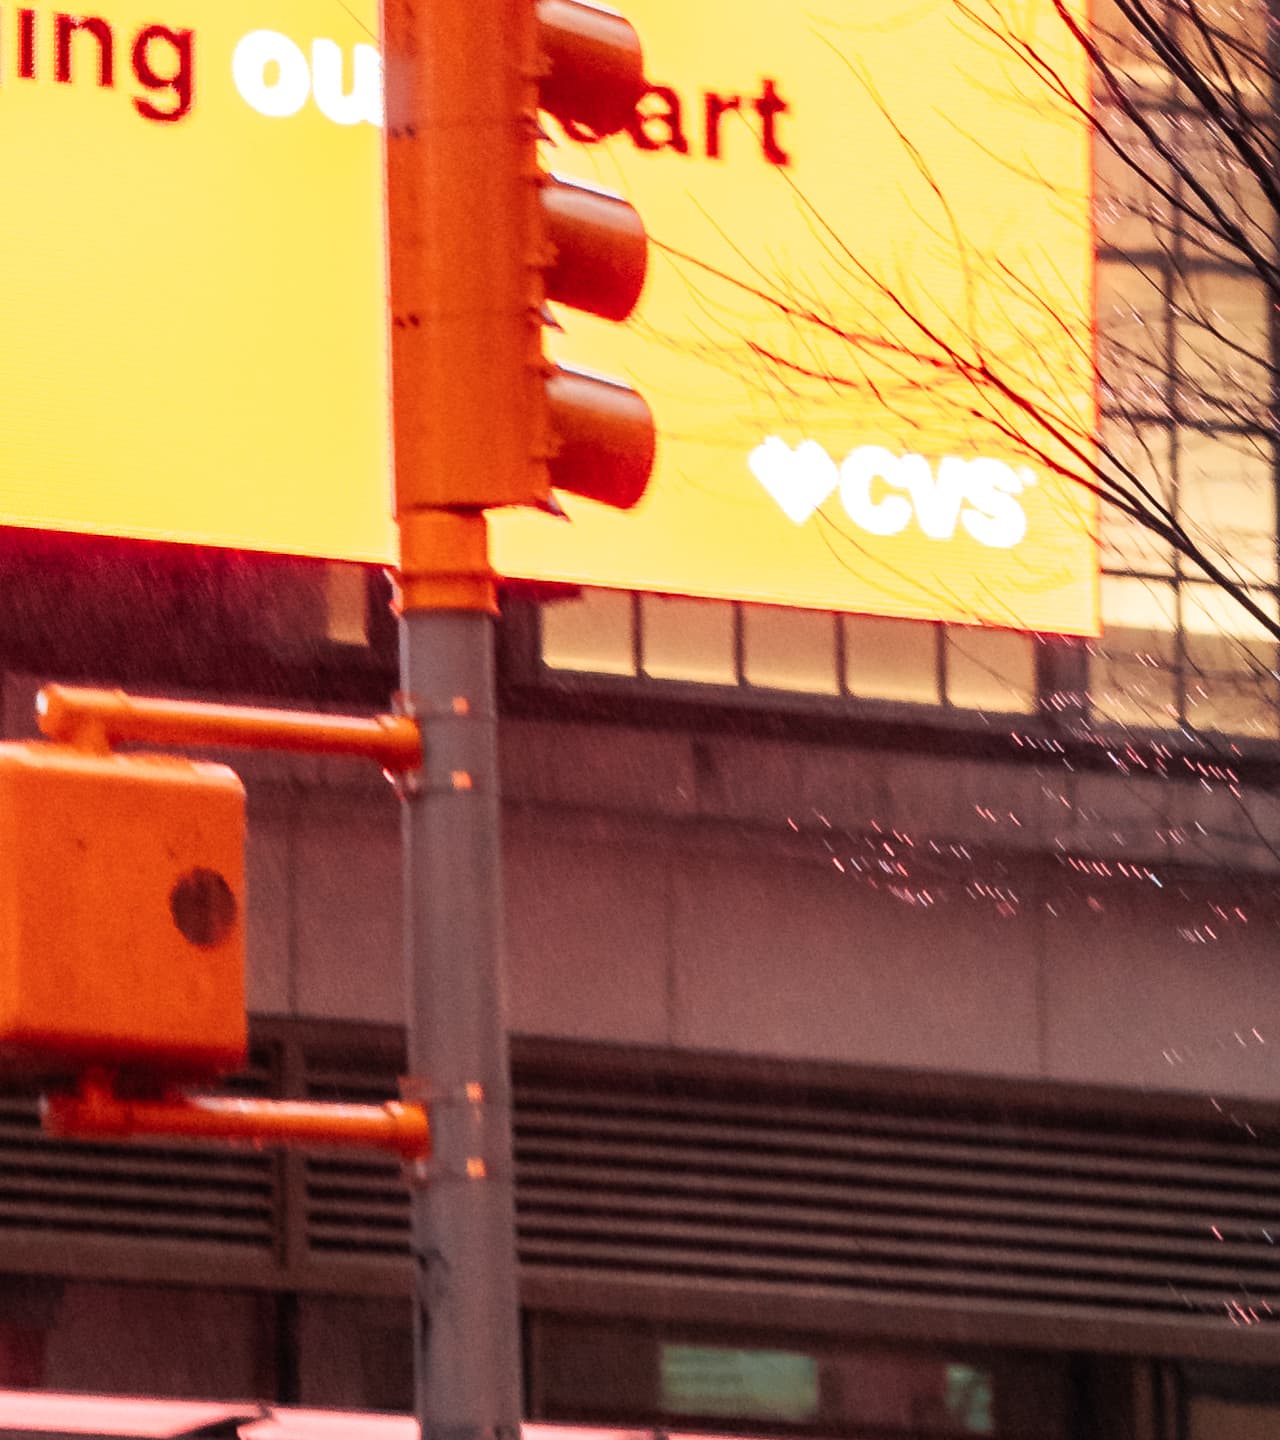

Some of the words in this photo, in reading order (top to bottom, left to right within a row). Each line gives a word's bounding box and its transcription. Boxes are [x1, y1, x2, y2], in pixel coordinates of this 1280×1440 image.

[231, 28, 383, 127] ou
[558, 78, 791, 166] art
[839, 443, 1030, 550] CVS
